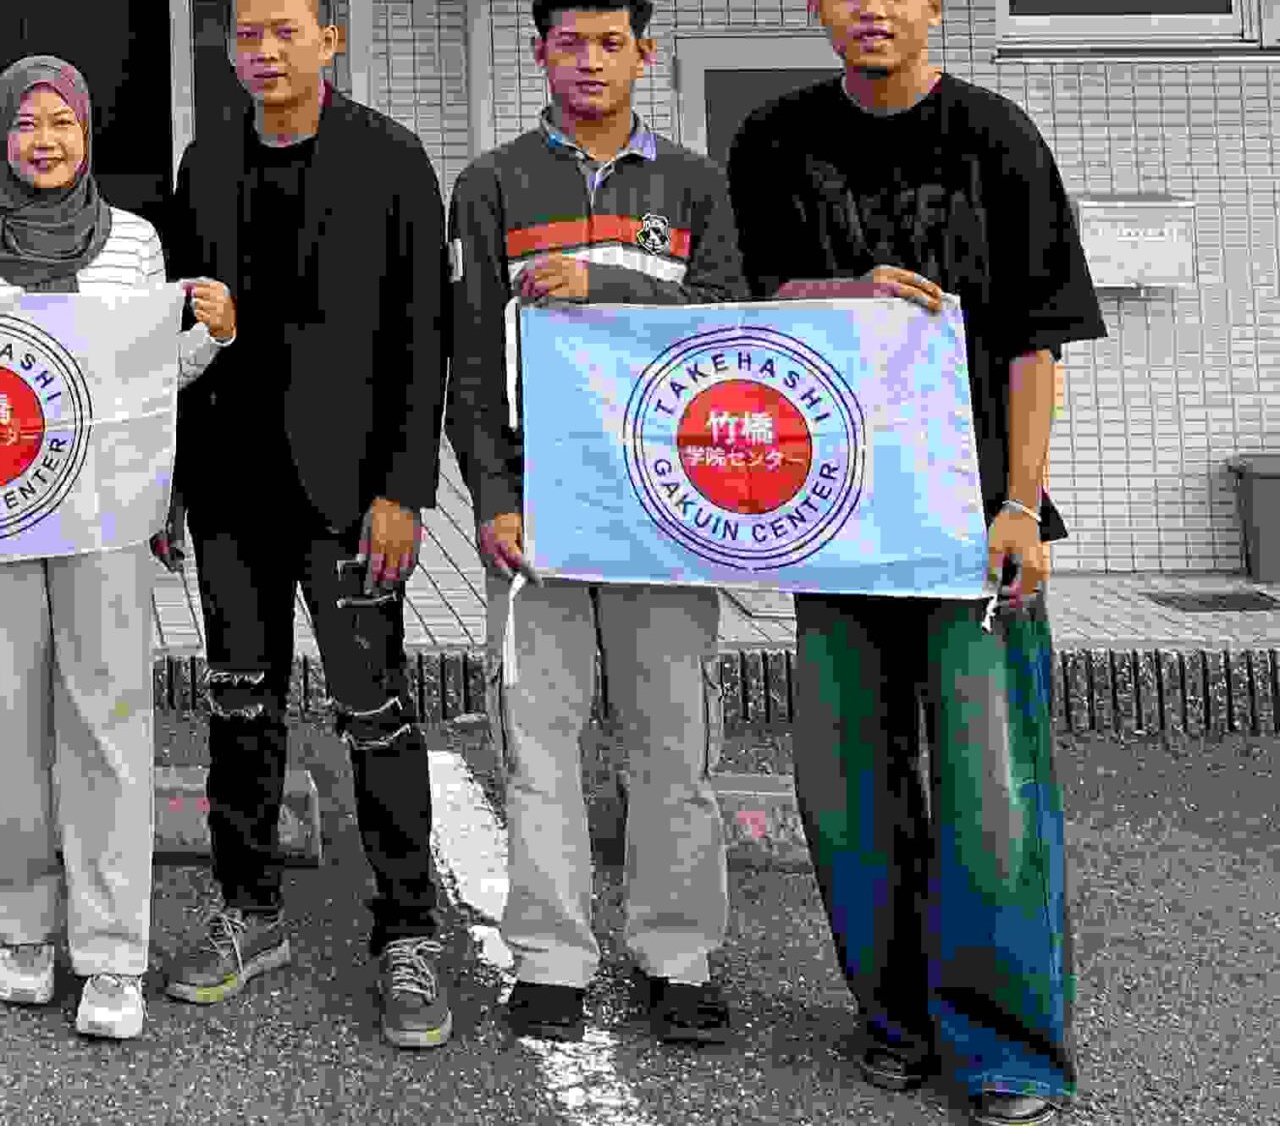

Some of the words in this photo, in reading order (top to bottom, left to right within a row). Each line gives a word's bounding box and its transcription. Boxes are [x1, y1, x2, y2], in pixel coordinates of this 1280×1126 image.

[654, 350, 832, 423] TAKEHASHI
[705, 410, 774, 446] 竹橋
[685, 445, 805, 473] 学院センター
[653, 457, 739, 542] GAKUIN
[751, 462, 840, 543] CENTER
